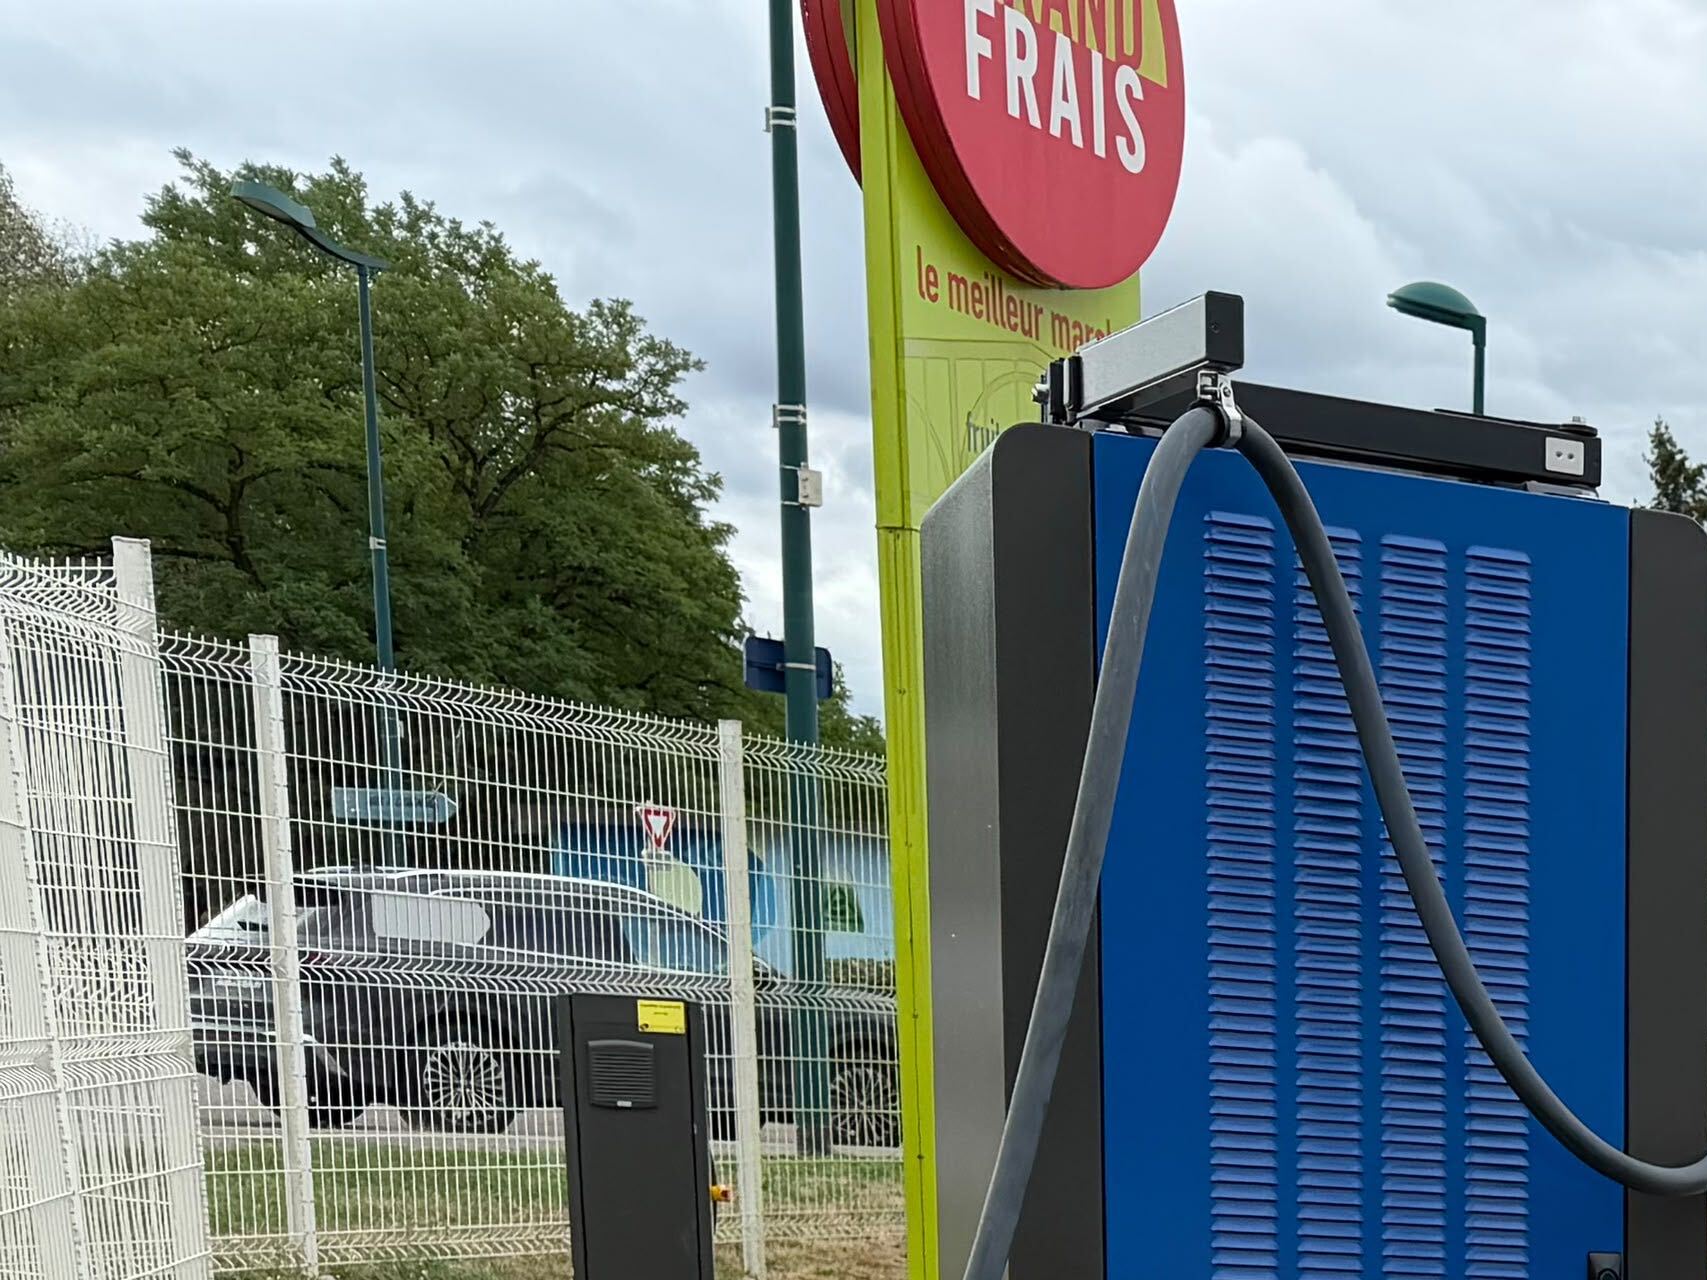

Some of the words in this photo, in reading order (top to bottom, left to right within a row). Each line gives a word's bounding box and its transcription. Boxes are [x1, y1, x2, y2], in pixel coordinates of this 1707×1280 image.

[963, 0, 1146, 174] FRAIS
[916, 245, 939, 304] le
[948, 270, 1044, 342] meilleur
